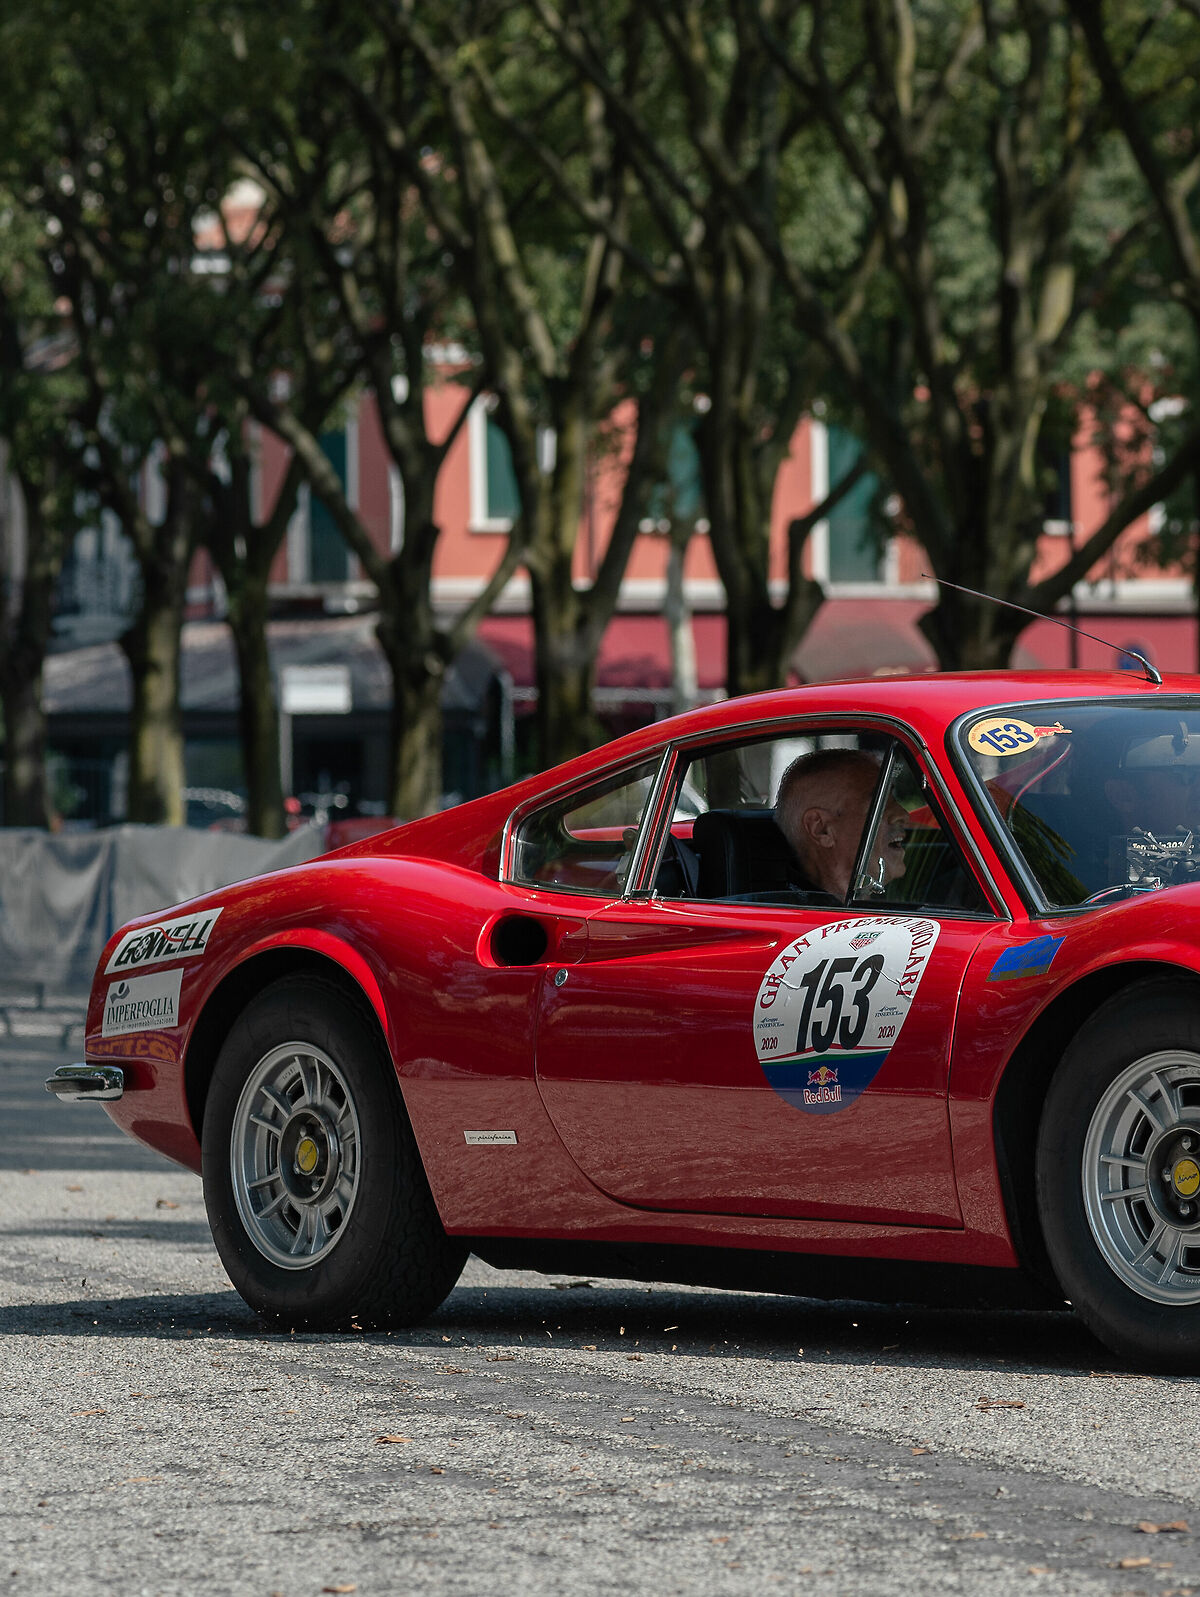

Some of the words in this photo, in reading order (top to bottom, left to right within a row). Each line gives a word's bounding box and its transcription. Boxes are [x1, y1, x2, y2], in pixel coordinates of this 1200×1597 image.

[978, 724, 1034, 753] 153
[114, 919, 213, 967] GOWELL
[760, 938, 811, 1009] GRAN
[820, 918, 913, 939] PREMIO
[107, 997, 173, 1025] IMPERFOGLIA
[796, 954, 885, 1053] 153
[761, 1037, 778, 1050] 2020
[877, 1025, 896, 1039] 2020
[804, 1087, 822, 1104] Red
[824, 1085, 841, 1102] Bull
